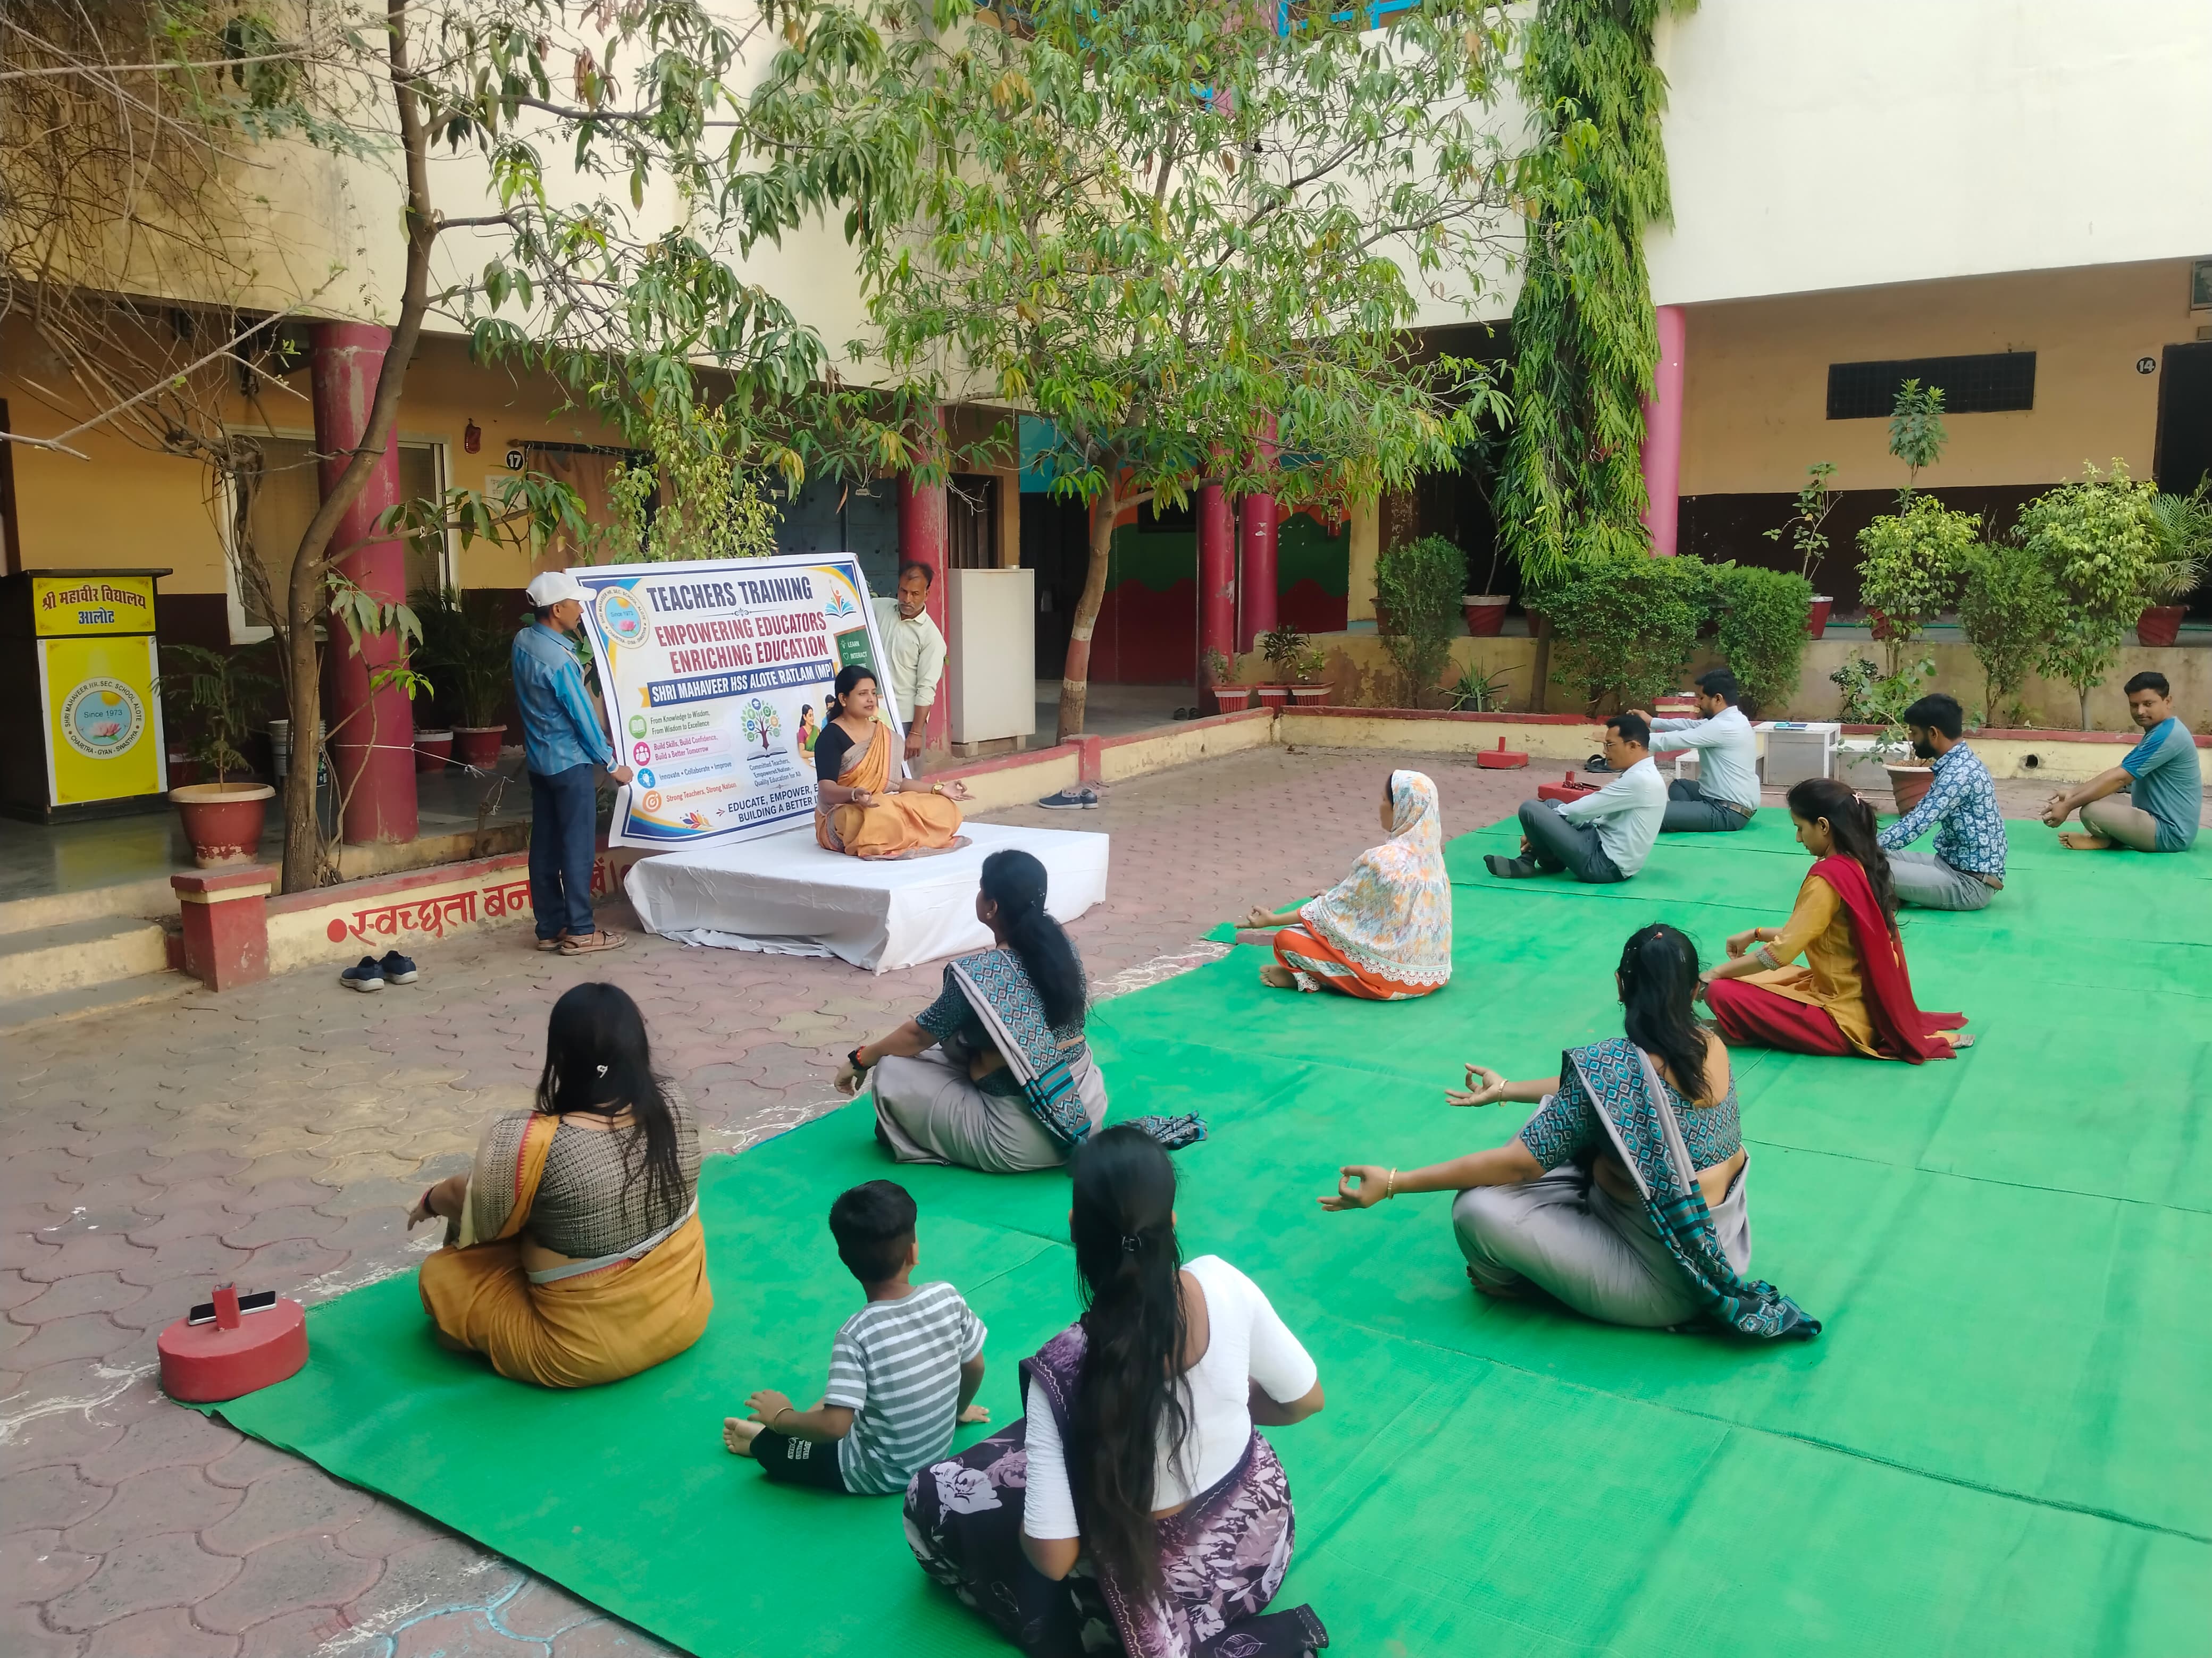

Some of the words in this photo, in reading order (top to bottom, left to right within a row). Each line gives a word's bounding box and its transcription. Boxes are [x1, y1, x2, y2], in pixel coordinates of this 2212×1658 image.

[2139, 360, 2155, 372] 14
[509, 454, 521, 467] 17
[43, 591, 57, 611] श्री
[59, 585, 99, 604] महावीर
[101, 585, 146, 609] विद्यालय
[646, 582, 737, 612] TEACHERS
[738, 576, 813, 604] TRAINING
[78, 607, 114, 624] आलोट
[655, 618, 754, 647] EMPOWERING
[755, 611, 826, 637] EDUCATORS
[669, 644, 753, 674] ENRICHING
[756, 635, 828, 663] EDUCATION
[850, 651, 867, 660] INTERACT
[652, 684, 677, 702] SHRI
[677, 678, 729, 698] MAHAVEER
[730, 675, 748, 691] HSS
[750, 671, 778, 689] ALOTE
[778, 666, 815, 684] RATLAM
[815, 662, 834, 680] (MP)
[65, 685, 88, 712] MAHAVEER
[663, 714, 687, 722] Knowledge
[664, 725, 682, 733] Wisdom
[688, 720, 709, 729] Excellence
[71, 735, 94, 754] CHARITRA
[115, 730, 139, 752] SWASTHYA
[680, 738, 692, 746] Build
[686, 746, 709, 755] Tomorrow
[659, 772, 680, 780] Innovate
[684, 765, 710, 776] Collaborate
[714, 762, 732, 770] Improve
[749, 761, 772, 771] Committed
[753, 768, 777, 778] Empowered
[769, 774, 789, 783] Education
[666, 794, 683, 802] Strong
[683, 788, 706, 798] Teachers,
[706, 785, 722, 794] Strong
[728, 796, 768, 813] EDUCATE,
[770, 786, 812, 803] EMPOWER,
[738, 805, 776, 822] BUILDING
[778, 804, 784, 813] A
[785, 796, 813, 811] BETTER
[348, 890, 477, 946] स्वच्छता
[482, 879, 533, 917] बन
